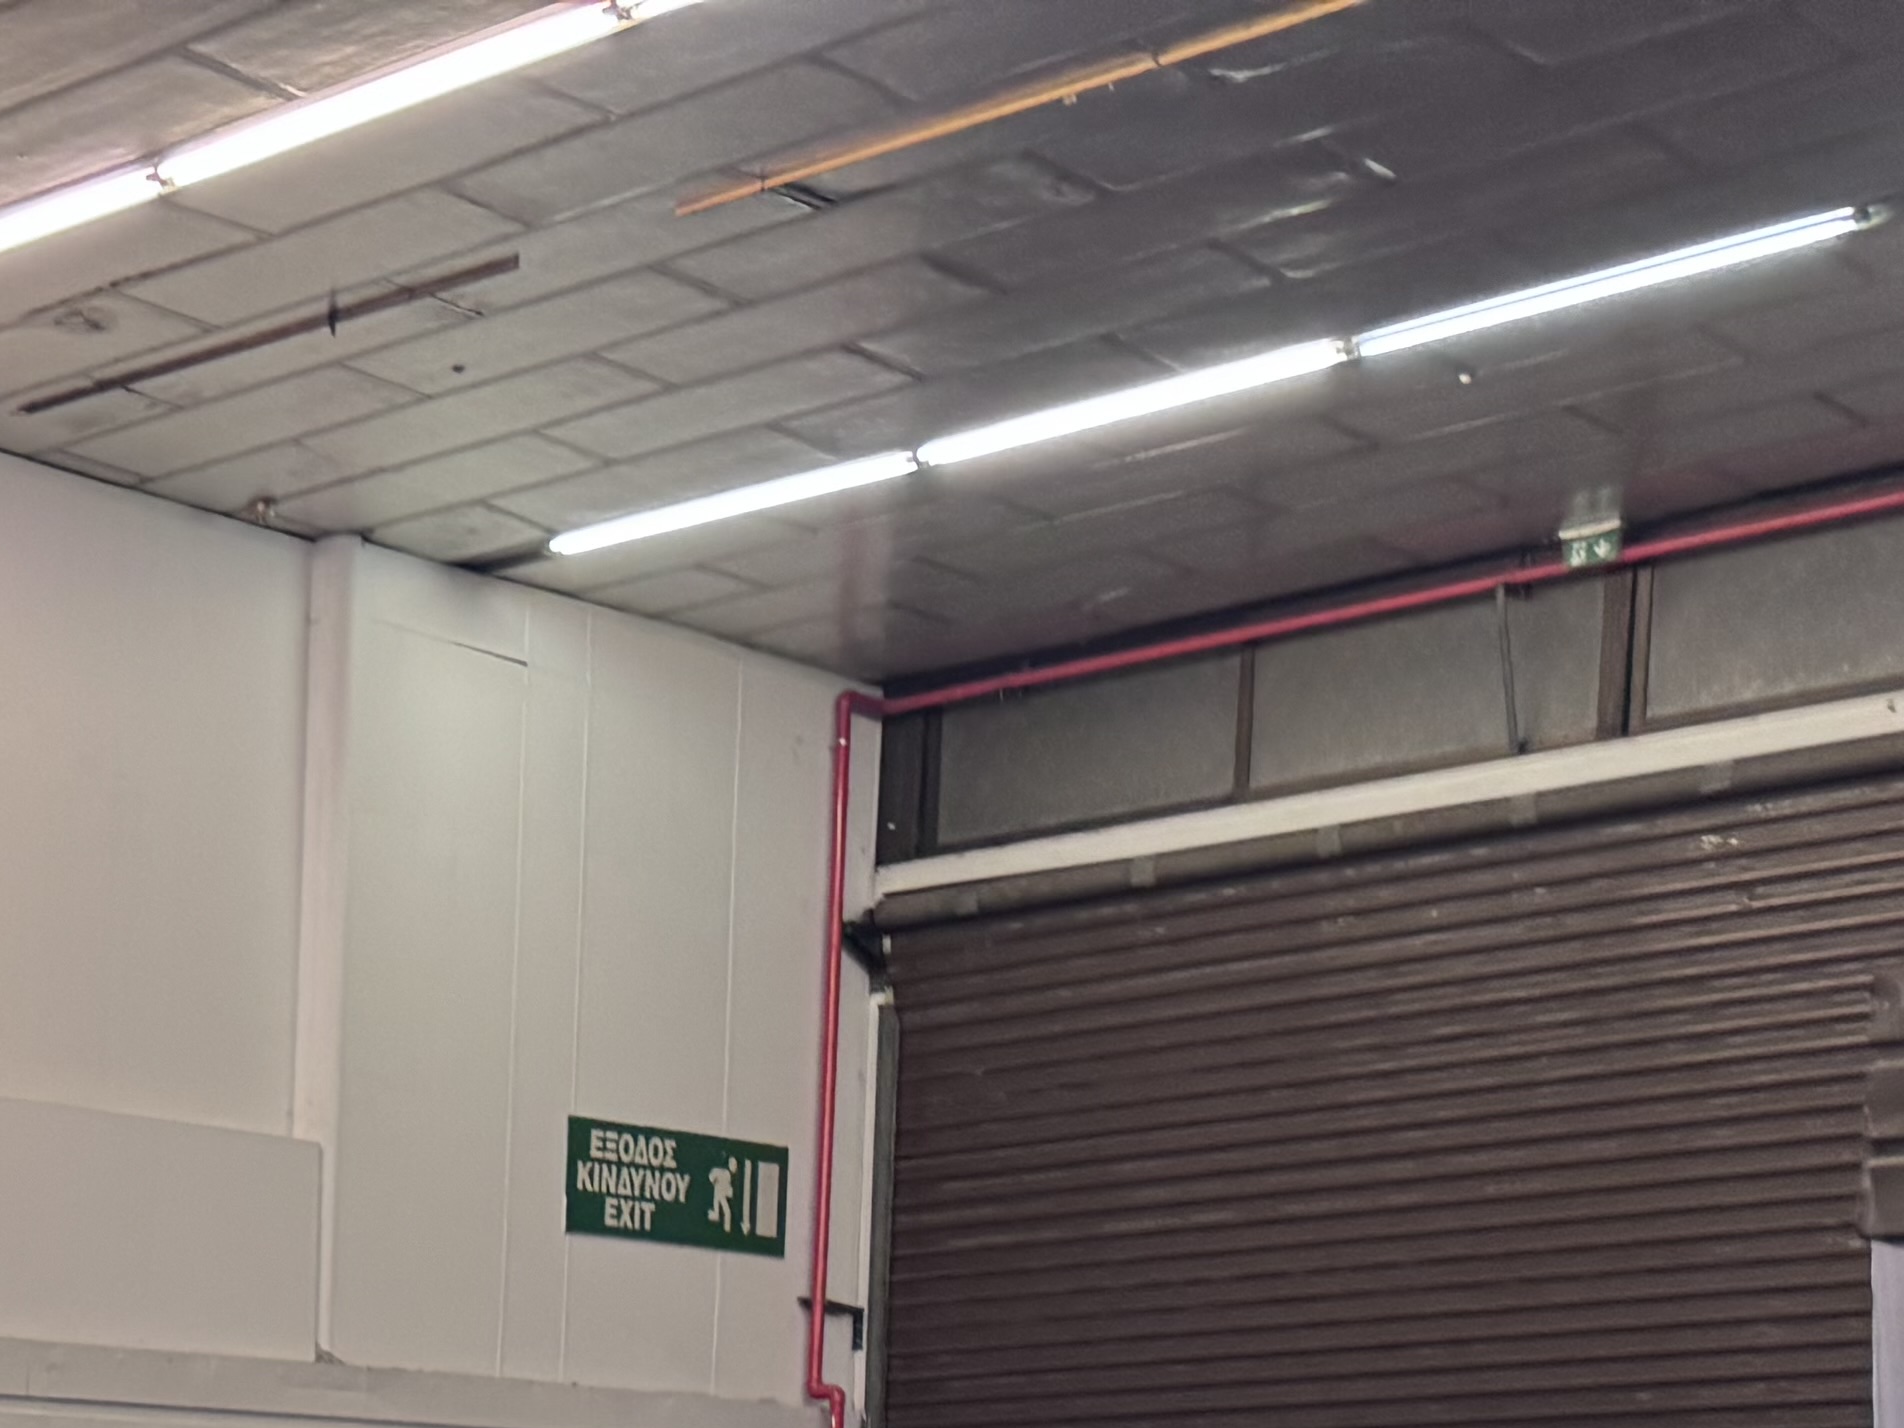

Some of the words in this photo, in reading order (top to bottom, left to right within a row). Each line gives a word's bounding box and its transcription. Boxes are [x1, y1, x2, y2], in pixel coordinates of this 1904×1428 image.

[590, 1128, 677, 1168] ΕΞΟΔΟΣ
[577, 1160, 691, 1203] ΚΙΝΔΥΝΟΥ
[604, 1198, 656, 1232] EXIT
